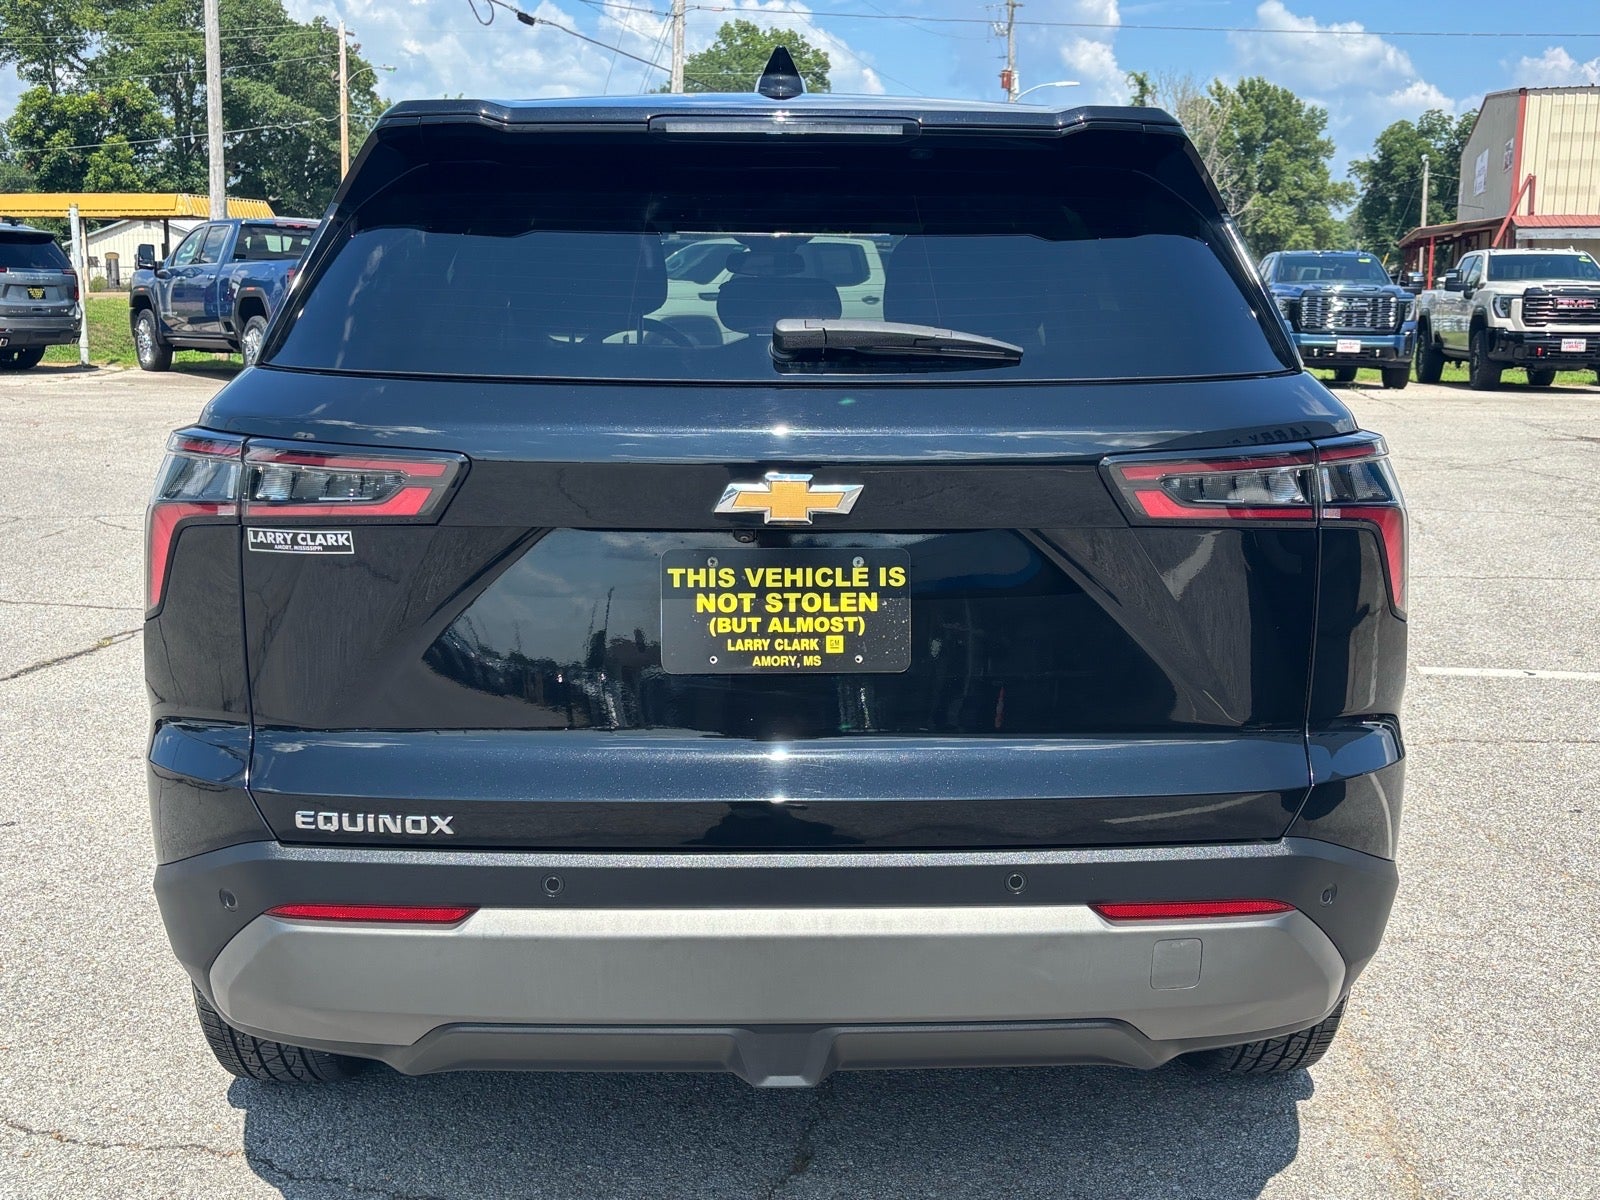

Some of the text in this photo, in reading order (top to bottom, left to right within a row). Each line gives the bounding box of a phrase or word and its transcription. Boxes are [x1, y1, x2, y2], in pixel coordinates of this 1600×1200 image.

[249, 531, 351, 546] LARRY CLARK
[667, 567, 906, 588] THIS VEHICLE IS
[696, 592, 878, 613] NOT STOLEN
[709, 616, 866, 637] (BUT ALMOST)
[727, 639, 770, 651] LARRY
[774, 638, 819, 651] CLARK
[752, 656, 822, 668] AMORY, MS
[295, 811, 454, 835] EQUINOX
